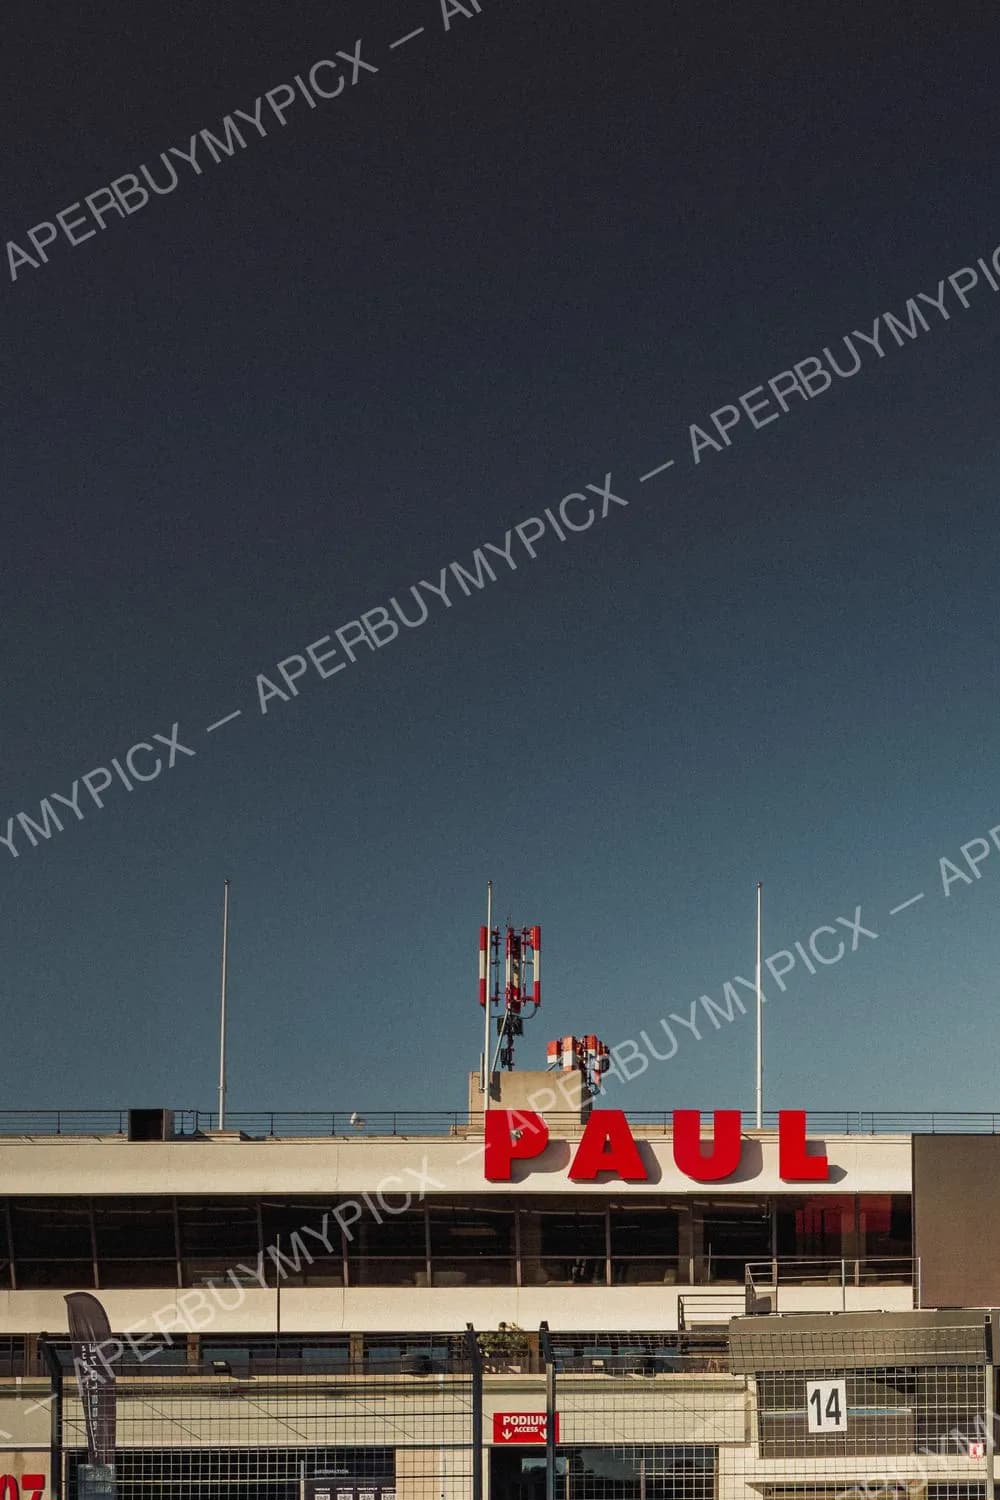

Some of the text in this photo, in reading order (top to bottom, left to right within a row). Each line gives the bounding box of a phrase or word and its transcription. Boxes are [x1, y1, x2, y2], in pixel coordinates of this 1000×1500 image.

[485, 1109, 829, 1182] PAUL
[502, 1415, 547, 1426] PODIUM
[809, 1388, 842, 1426] 14
